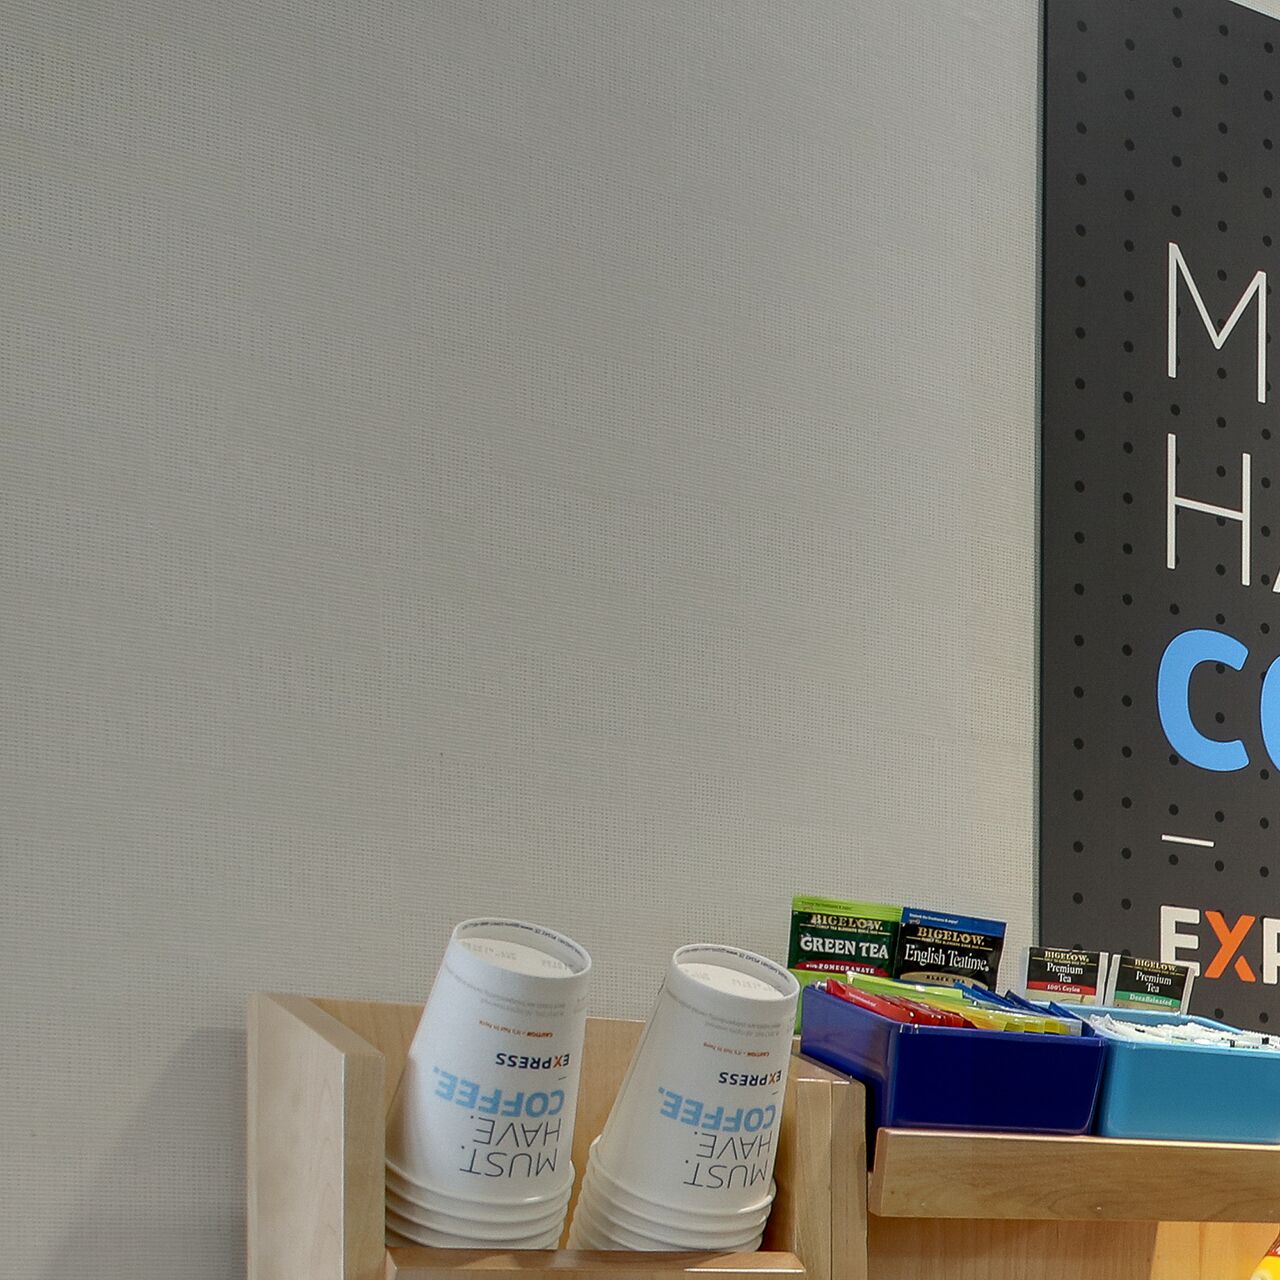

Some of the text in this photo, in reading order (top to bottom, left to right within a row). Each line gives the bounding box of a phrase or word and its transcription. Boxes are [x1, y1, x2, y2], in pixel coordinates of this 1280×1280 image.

[800, 936, 889, 959] GREEN TEA
[904, 943, 945, 966] English
[1047, 962, 1083, 975] Premium
[1057, 973, 1072, 983] Tea
[1135, 970, 1172, 985] Premium
[1146, 982, 1160, 993] Tea
[495, 1053, 570, 1070] EXPRESS
[718, 1070, 782, 1086] EXPRESS
[432, 1066, 565, 1118] COFFEE.
[658, 1087, 776, 1133] COFFEE.
[470, 1115, 561, 1147] HAVE.
[694, 1130, 773, 1160] HAVE.
[460, 1145, 557, 1178] MUST.
[683, 1159, 768, 1189] MUST.
